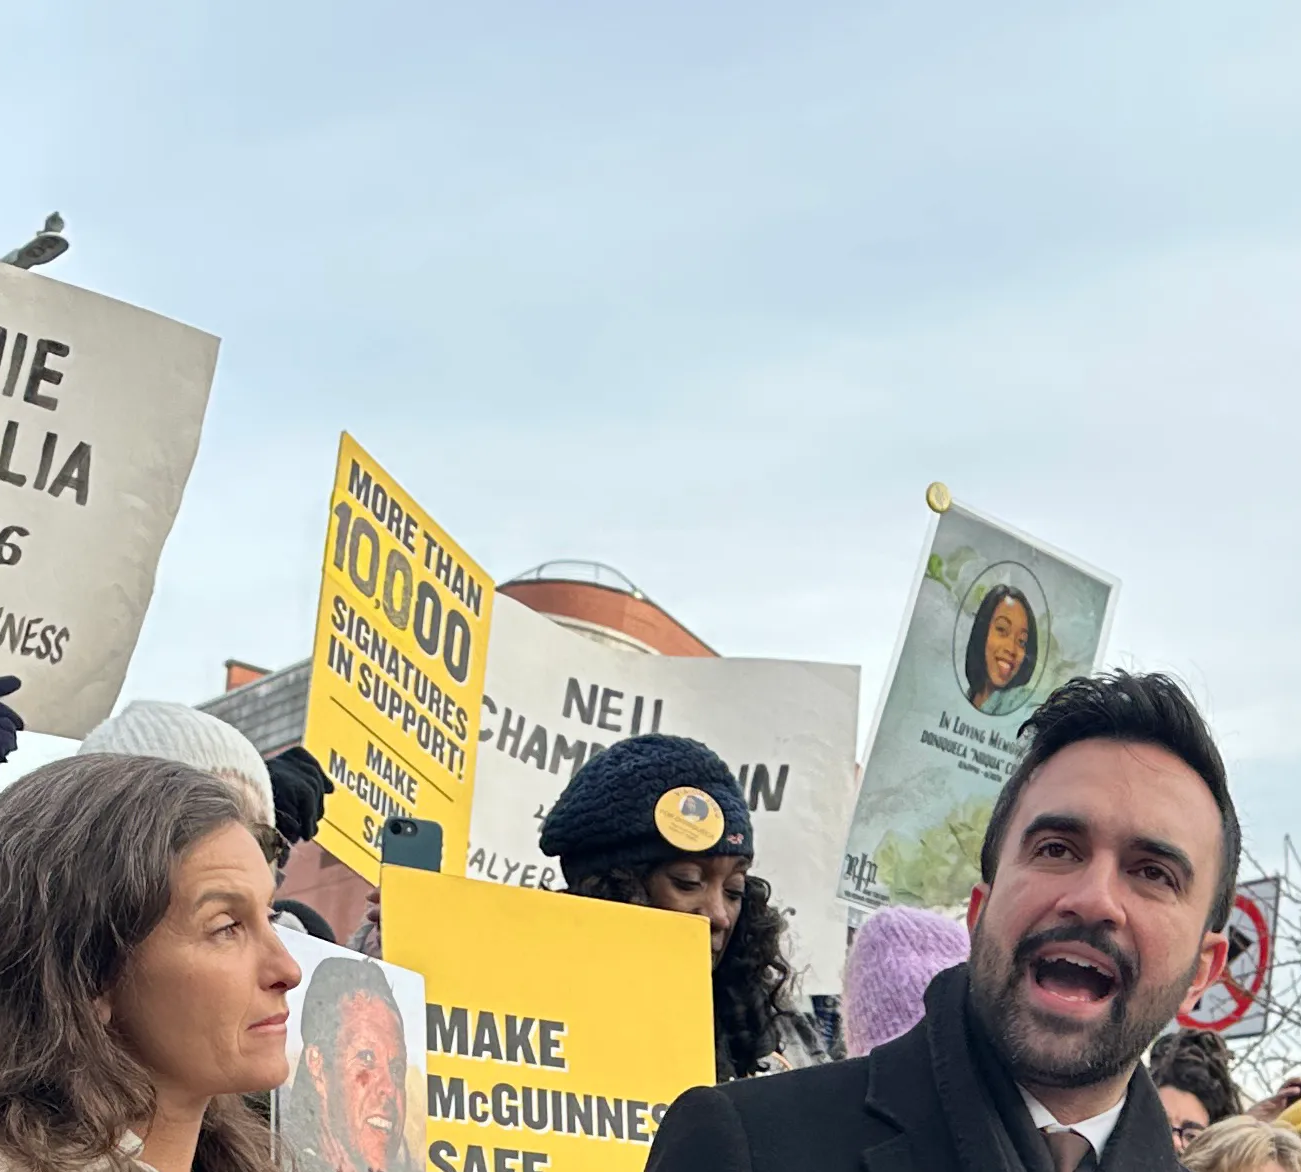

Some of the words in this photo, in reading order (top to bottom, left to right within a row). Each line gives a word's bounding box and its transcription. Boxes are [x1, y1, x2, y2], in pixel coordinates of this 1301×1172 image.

[333, 500, 471, 683] 10,000
[348, 457, 418, 554] MORE
[423, 529, 483, 618] THAN
[327, 634, 354, 683] IN
[357, 662, 466, 779] SUPPORT!
[331, 594, 469, 741] SIGNATURES
[366, 739, 418, 805] MAKE
[425, 1002, 566, 1069] MAKE
